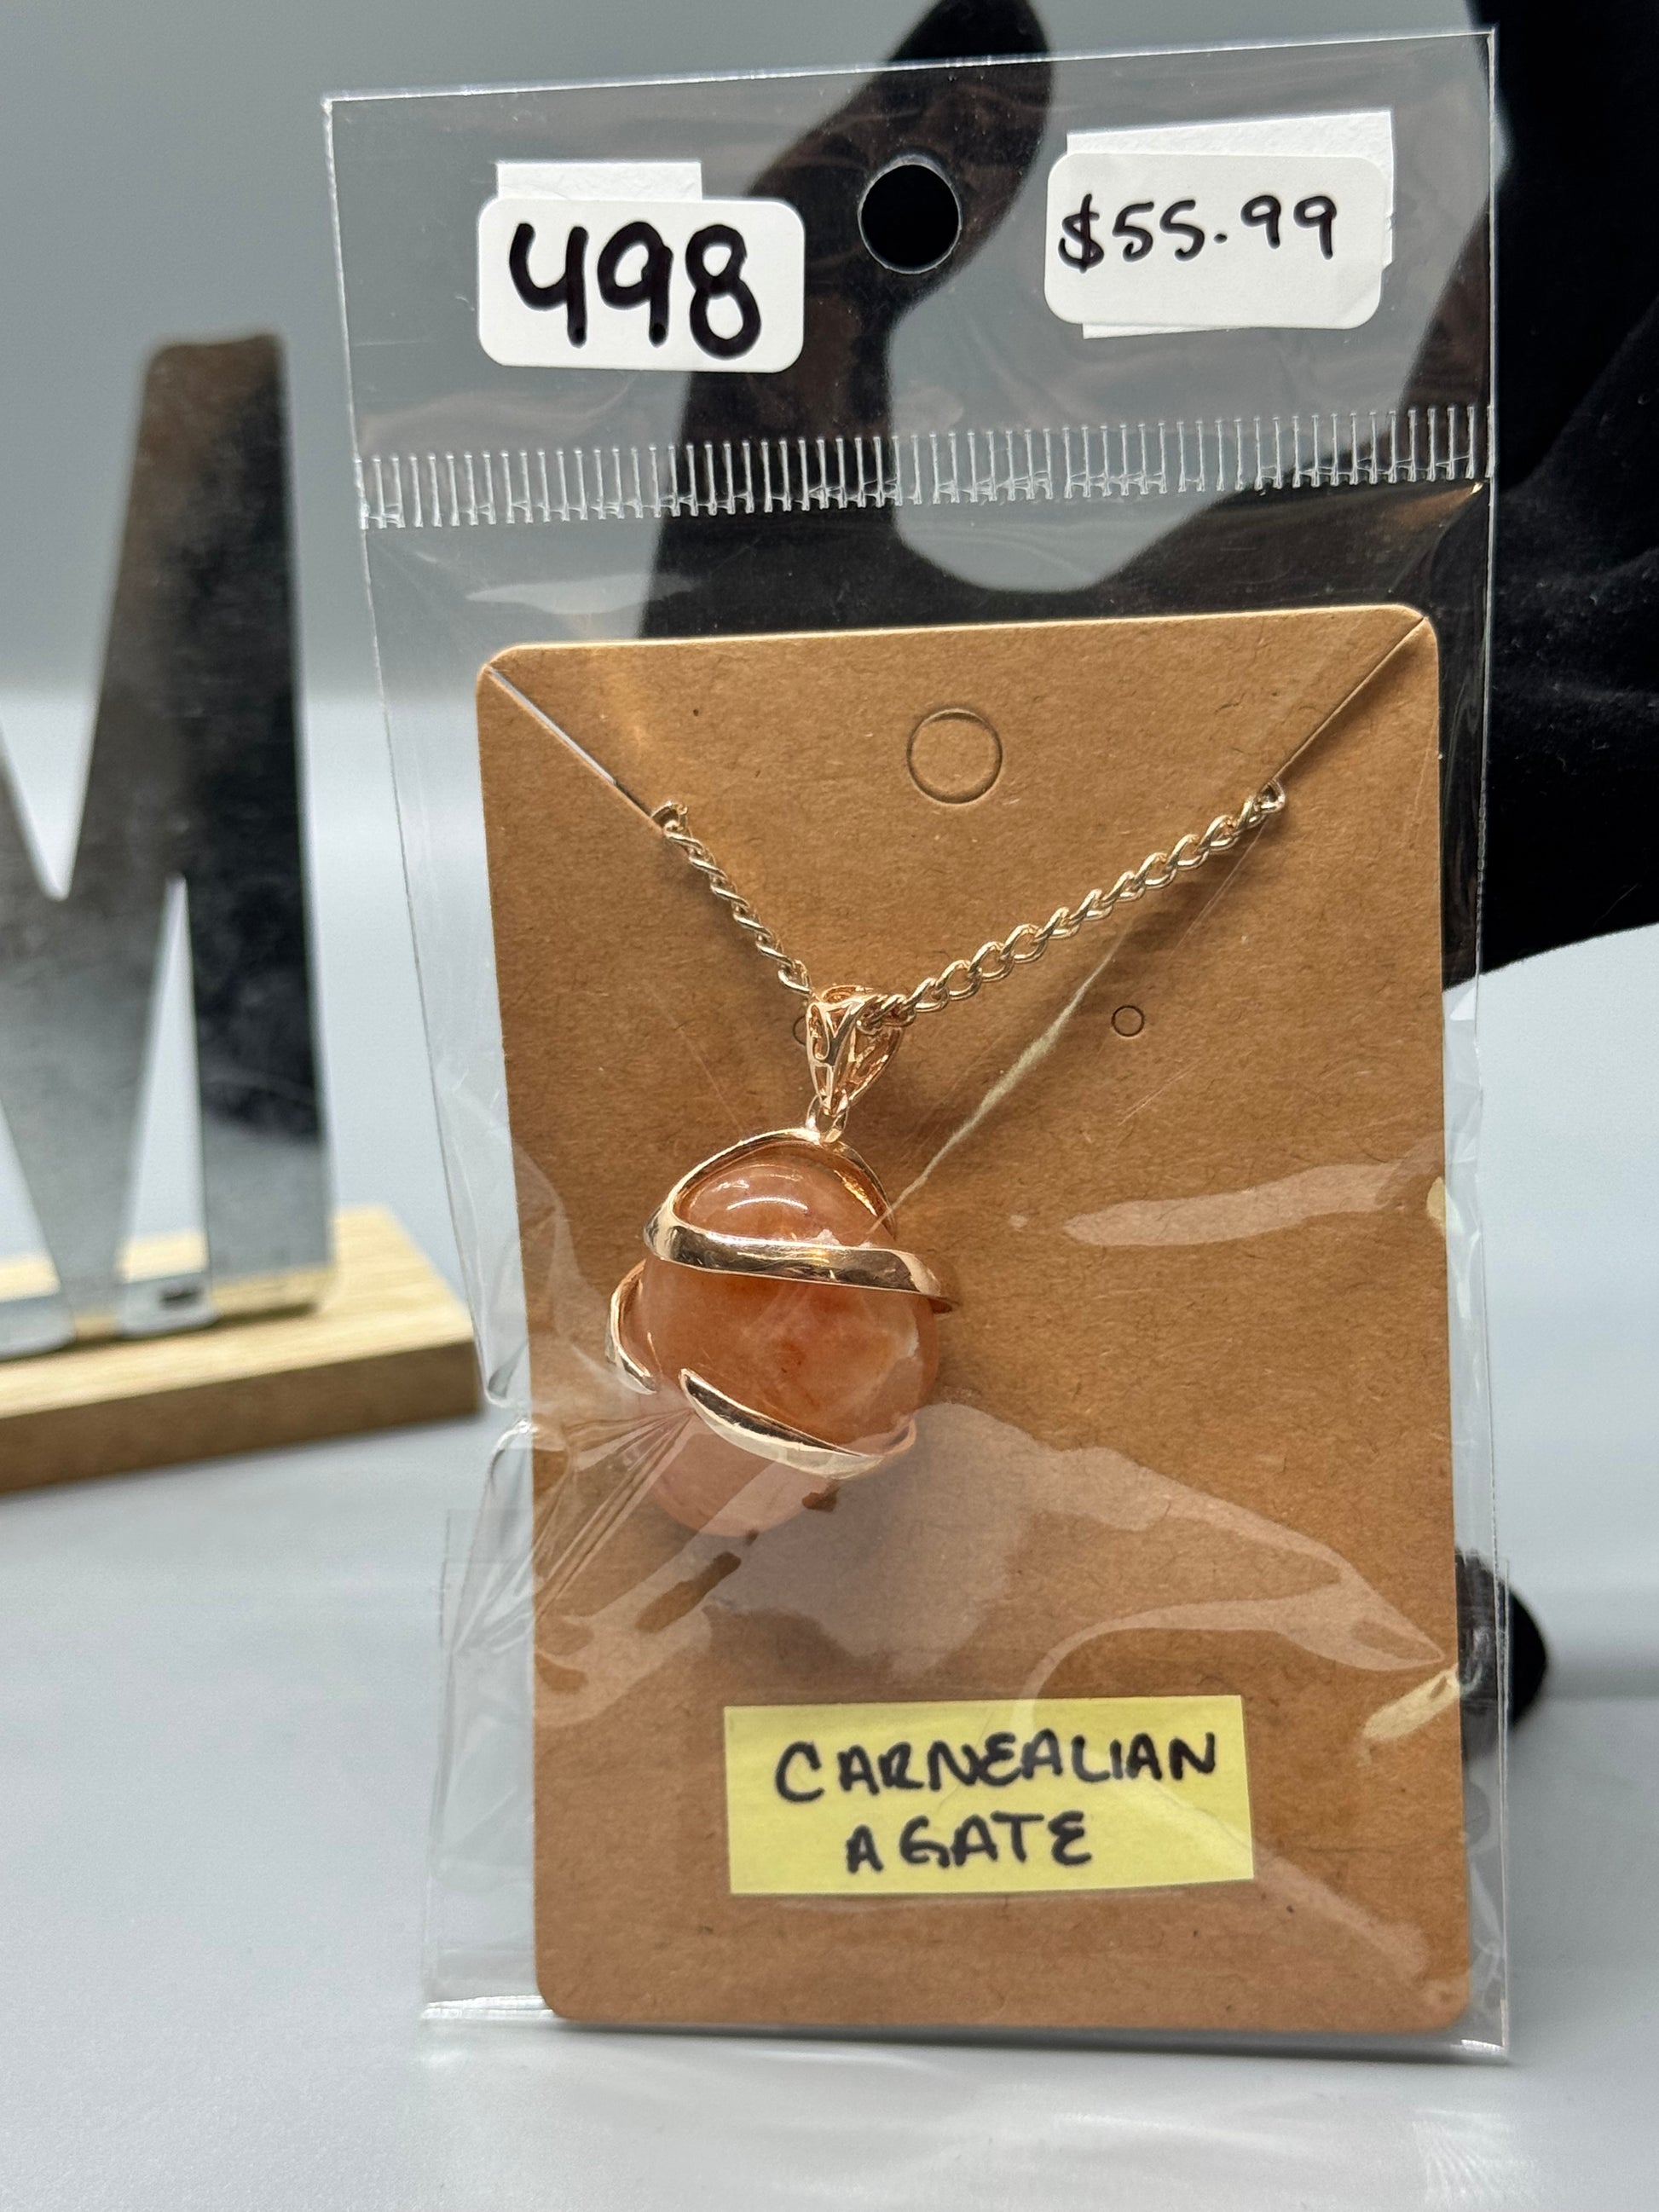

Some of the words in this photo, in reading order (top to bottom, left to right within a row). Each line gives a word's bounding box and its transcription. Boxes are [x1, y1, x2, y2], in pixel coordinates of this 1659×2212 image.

[1057, 193, 1338, 272] $55.99
[507, 219, 762, 360] 498
[774, 1727, 1217, 1803] CARNEALIAN
[845, 1810, 1093, 1874] AGATE
